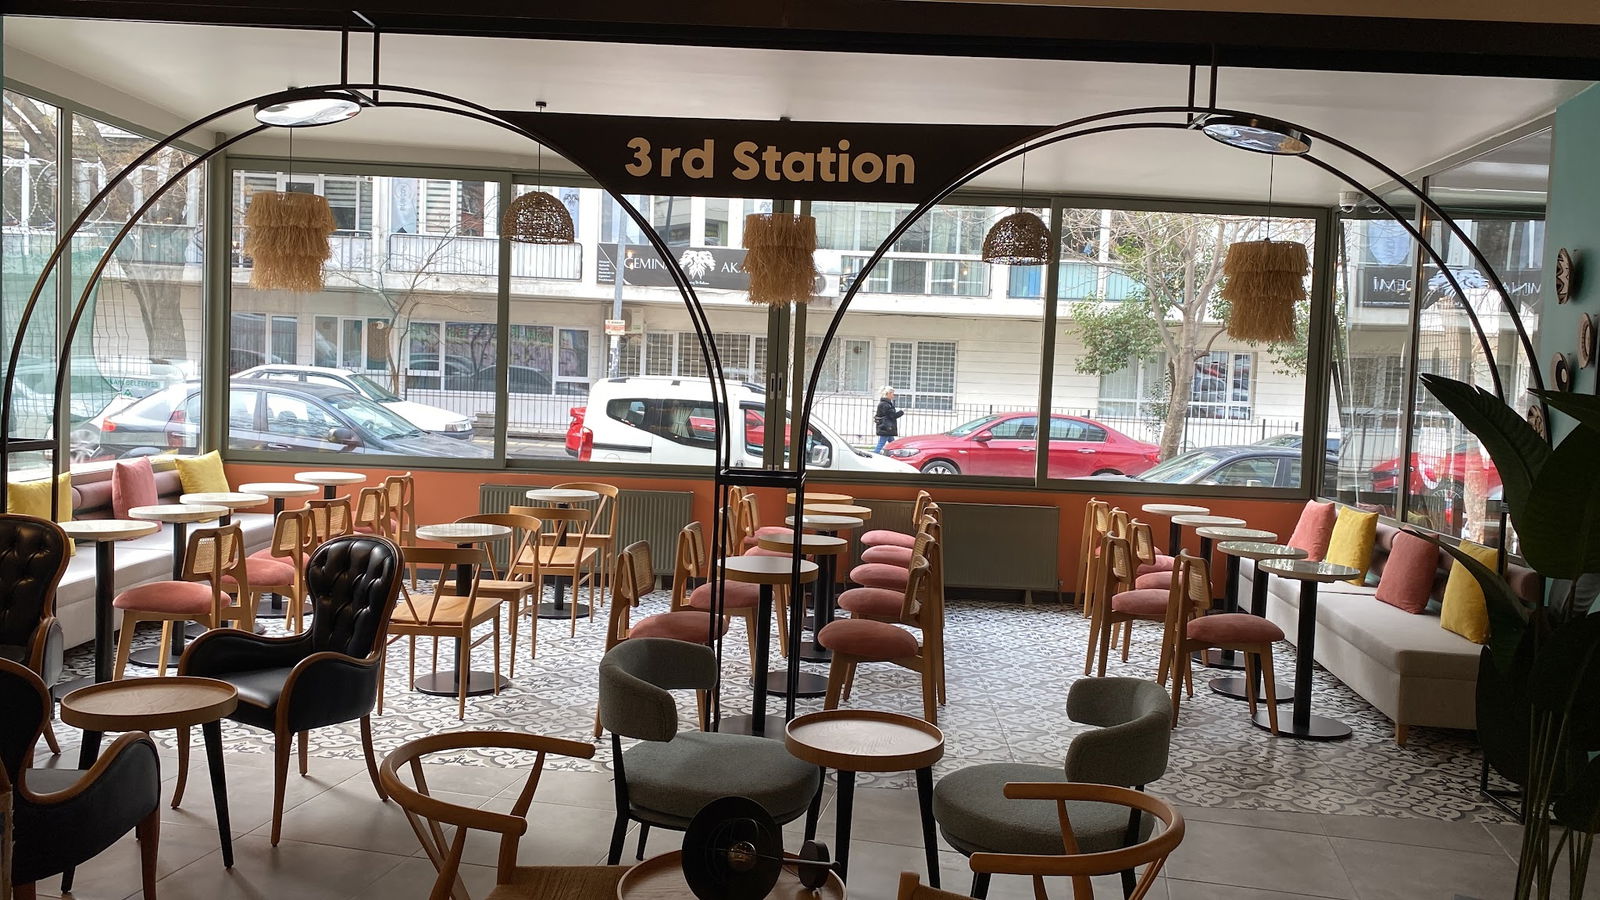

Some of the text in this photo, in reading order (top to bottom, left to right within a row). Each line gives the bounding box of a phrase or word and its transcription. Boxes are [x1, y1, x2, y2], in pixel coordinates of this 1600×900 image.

[624, 136, 916, 185] 3rd Station
[624, 257, 668, 270] GEMIN
